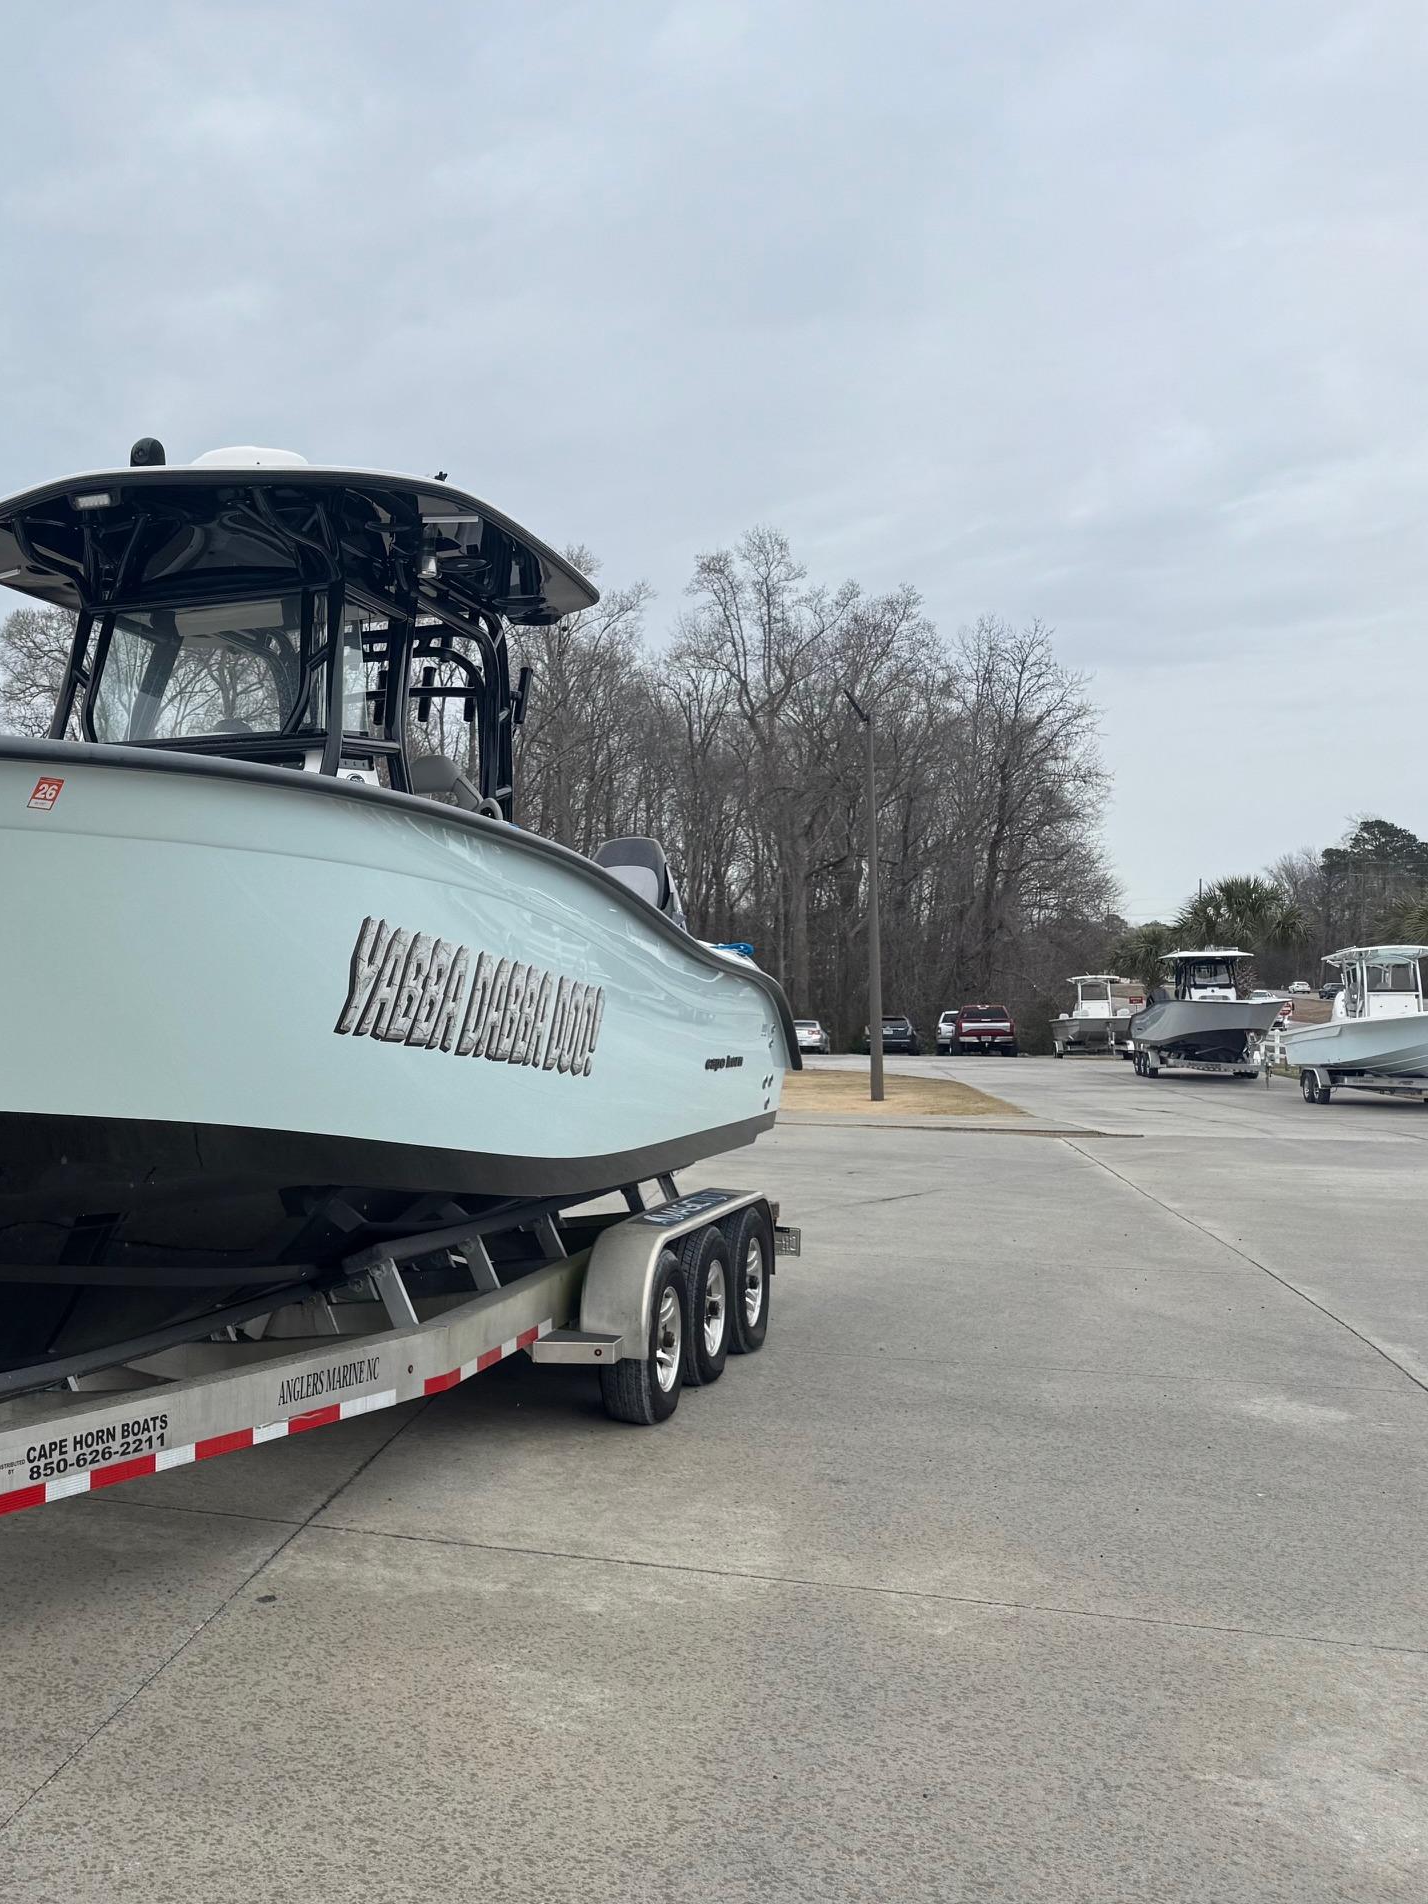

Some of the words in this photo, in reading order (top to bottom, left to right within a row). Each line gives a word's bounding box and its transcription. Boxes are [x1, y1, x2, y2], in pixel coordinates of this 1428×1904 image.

[35, 784, 58, 800] 26
[333, 915, 470, 1053] YABBA
[454, 951, 554, 1069] DABBA
[278, 1371, 325, 1405] ANGLERS
[325, 1361, 365, 1392] MARINE
[366, 1357, 380, 1382] NC
[26, 1438, 68, 1464] CAPE
[73, 1426, 116, 1452] HORN
[121, 1414, 169, 1440] BOATS
[29, 1432, 165, 1481] 850-626-2211
